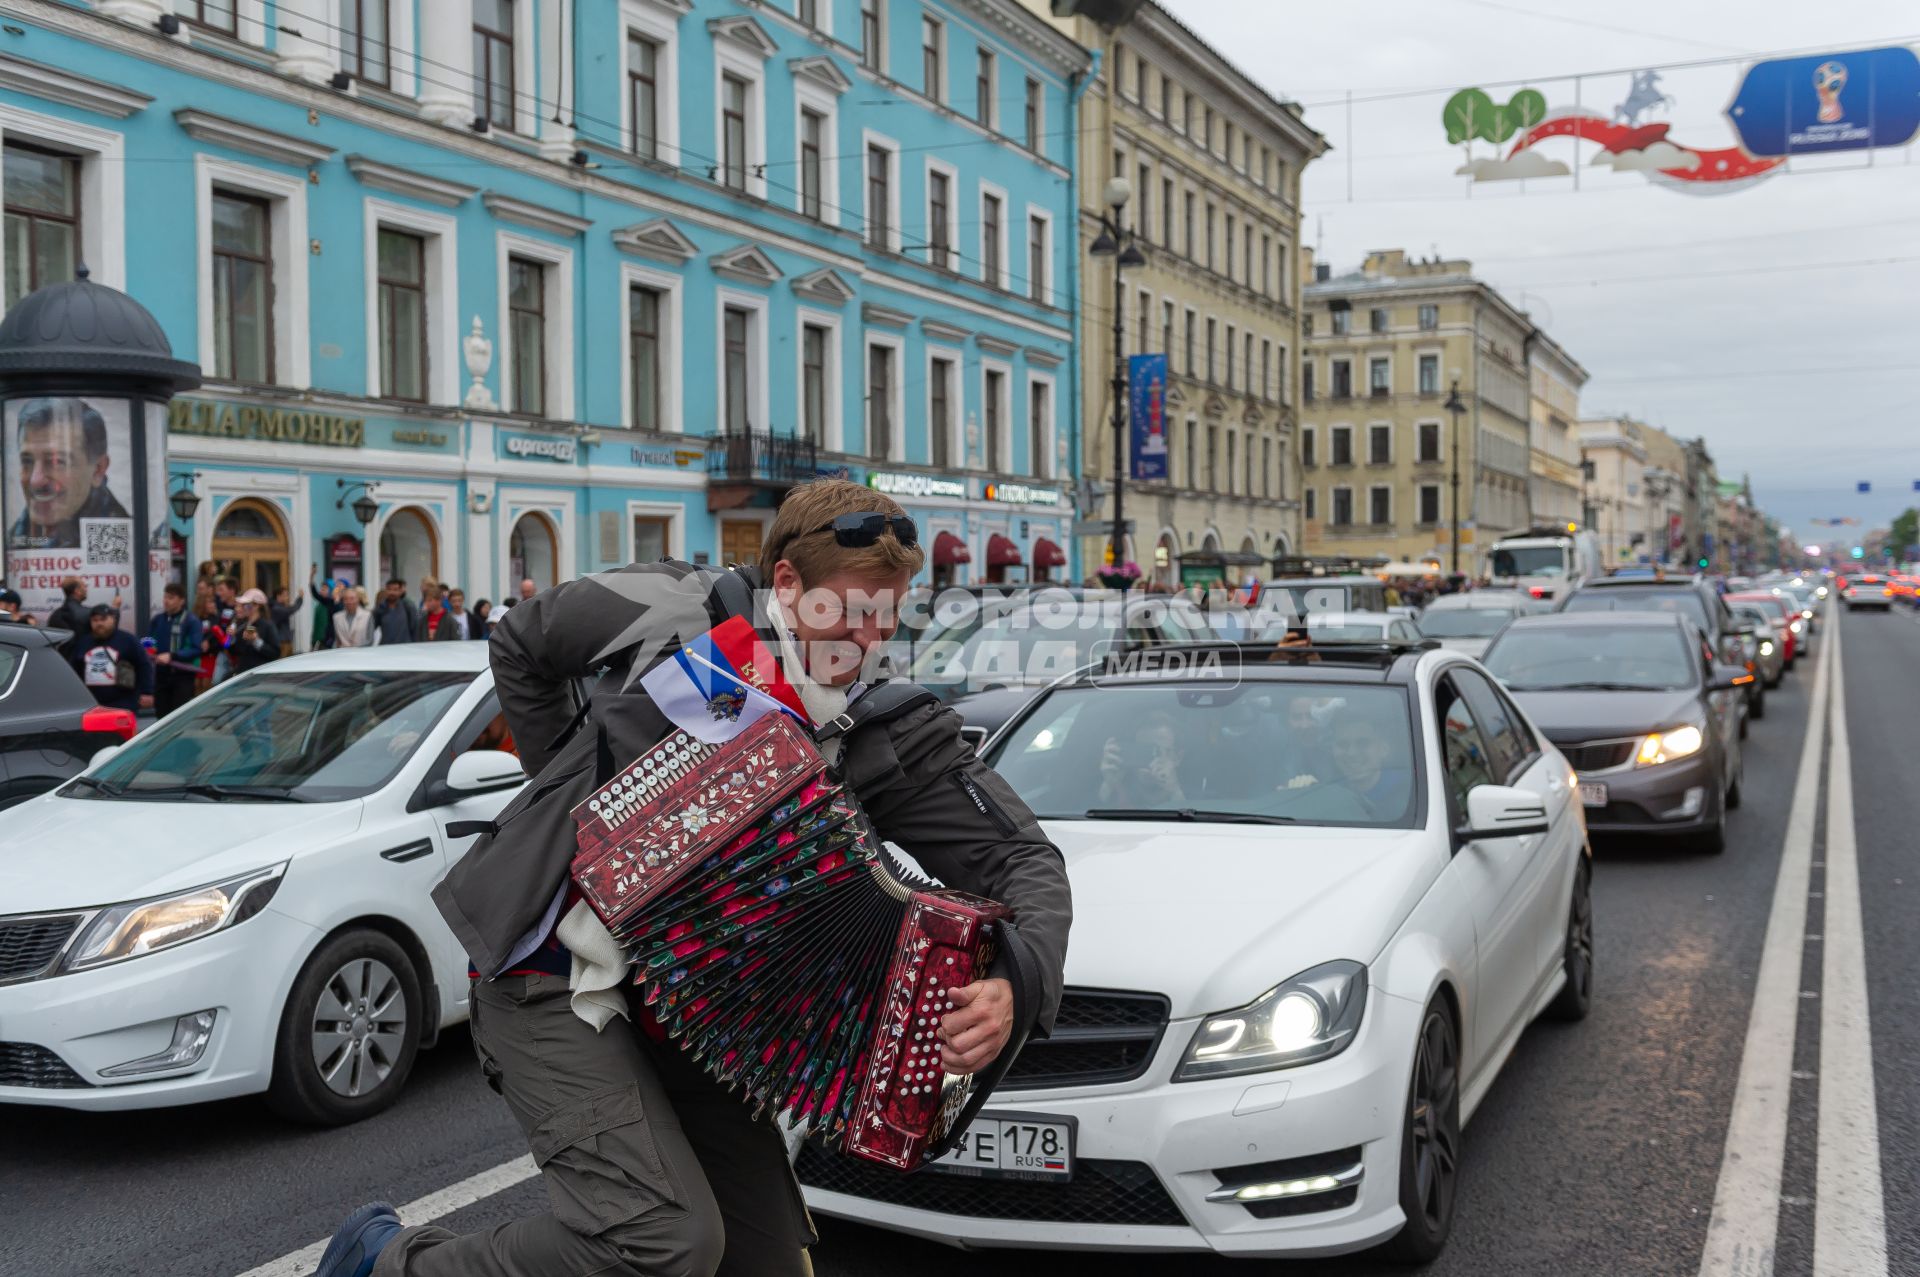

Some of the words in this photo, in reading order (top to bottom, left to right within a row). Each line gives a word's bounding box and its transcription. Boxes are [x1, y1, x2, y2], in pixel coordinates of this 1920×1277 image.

[169, 401, 366, 446] ИЛАРМОНИЯ
[20, 573, 130, 589] агентво
[1003, 1125, 1058, 1156] 178
[1015, 1156, 1043, 1167] RUS
